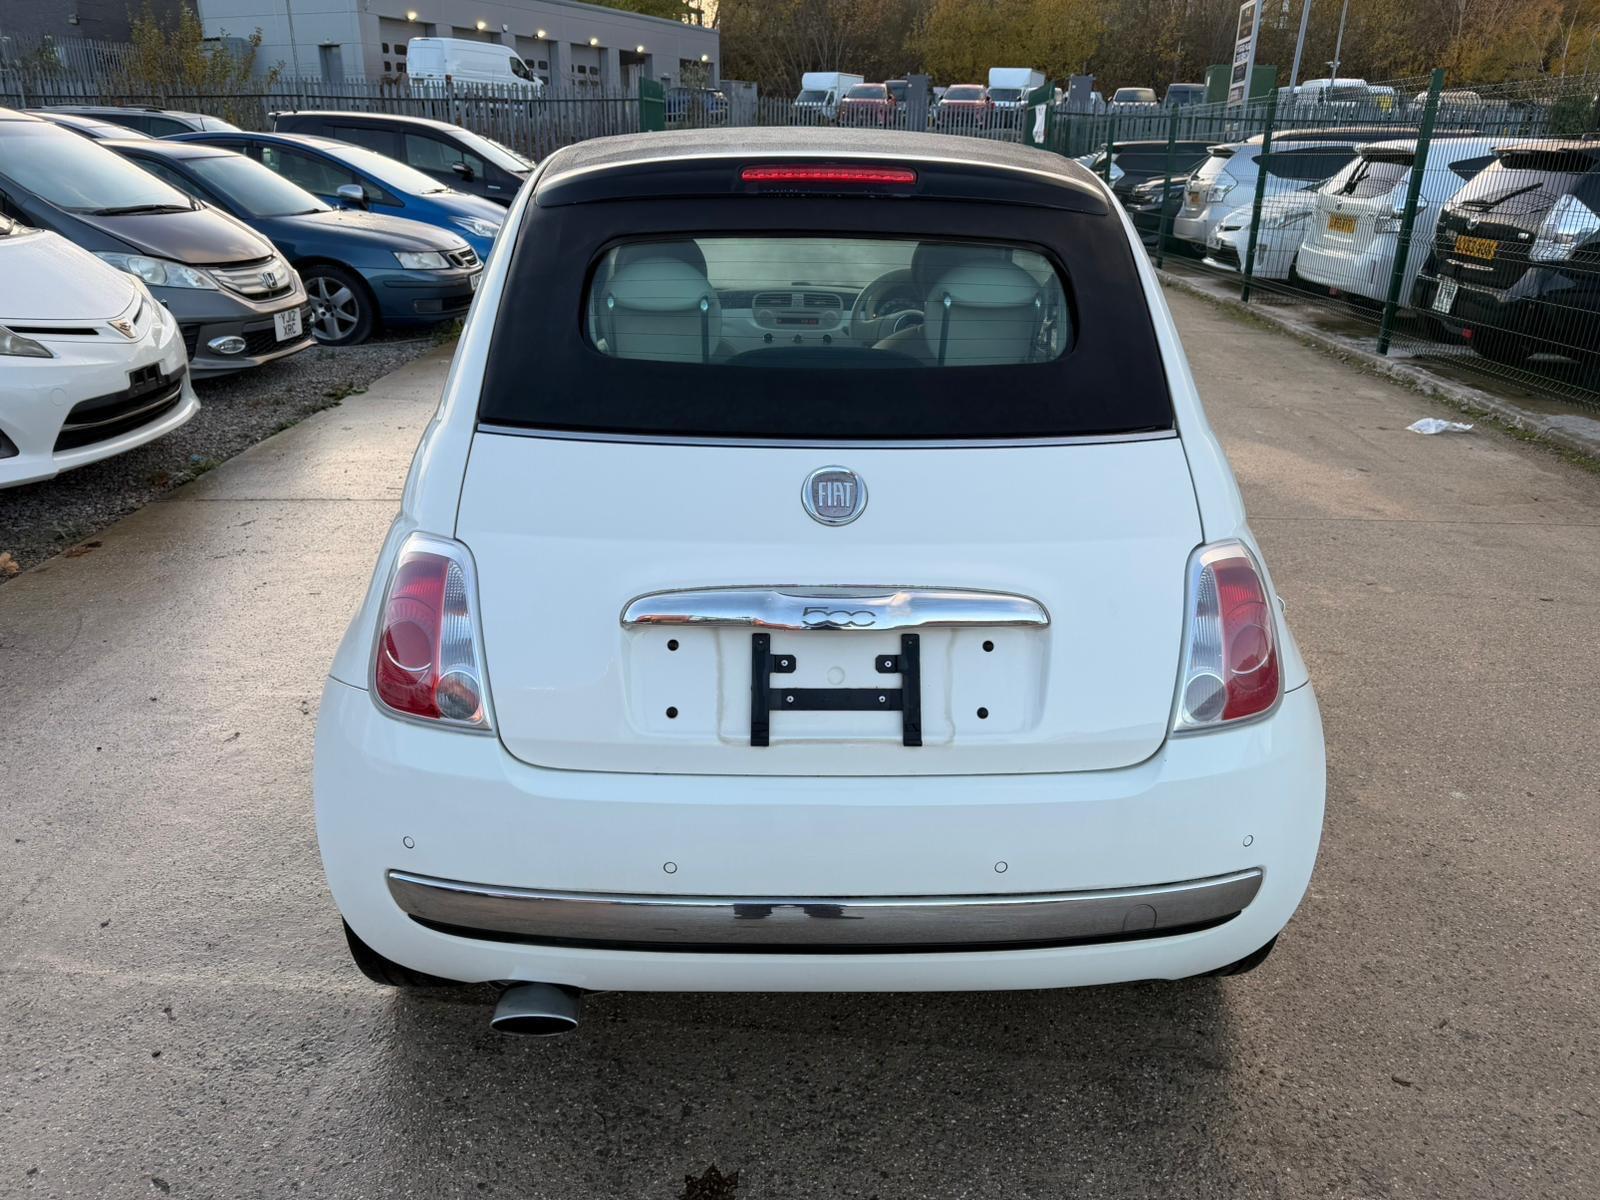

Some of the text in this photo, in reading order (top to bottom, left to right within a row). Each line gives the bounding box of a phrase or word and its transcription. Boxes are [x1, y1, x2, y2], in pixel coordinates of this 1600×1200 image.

[283, 322, 297, 337] XRC
[818, 481, 853, 507] FIAT
[802, 607, 876, 626] 500
